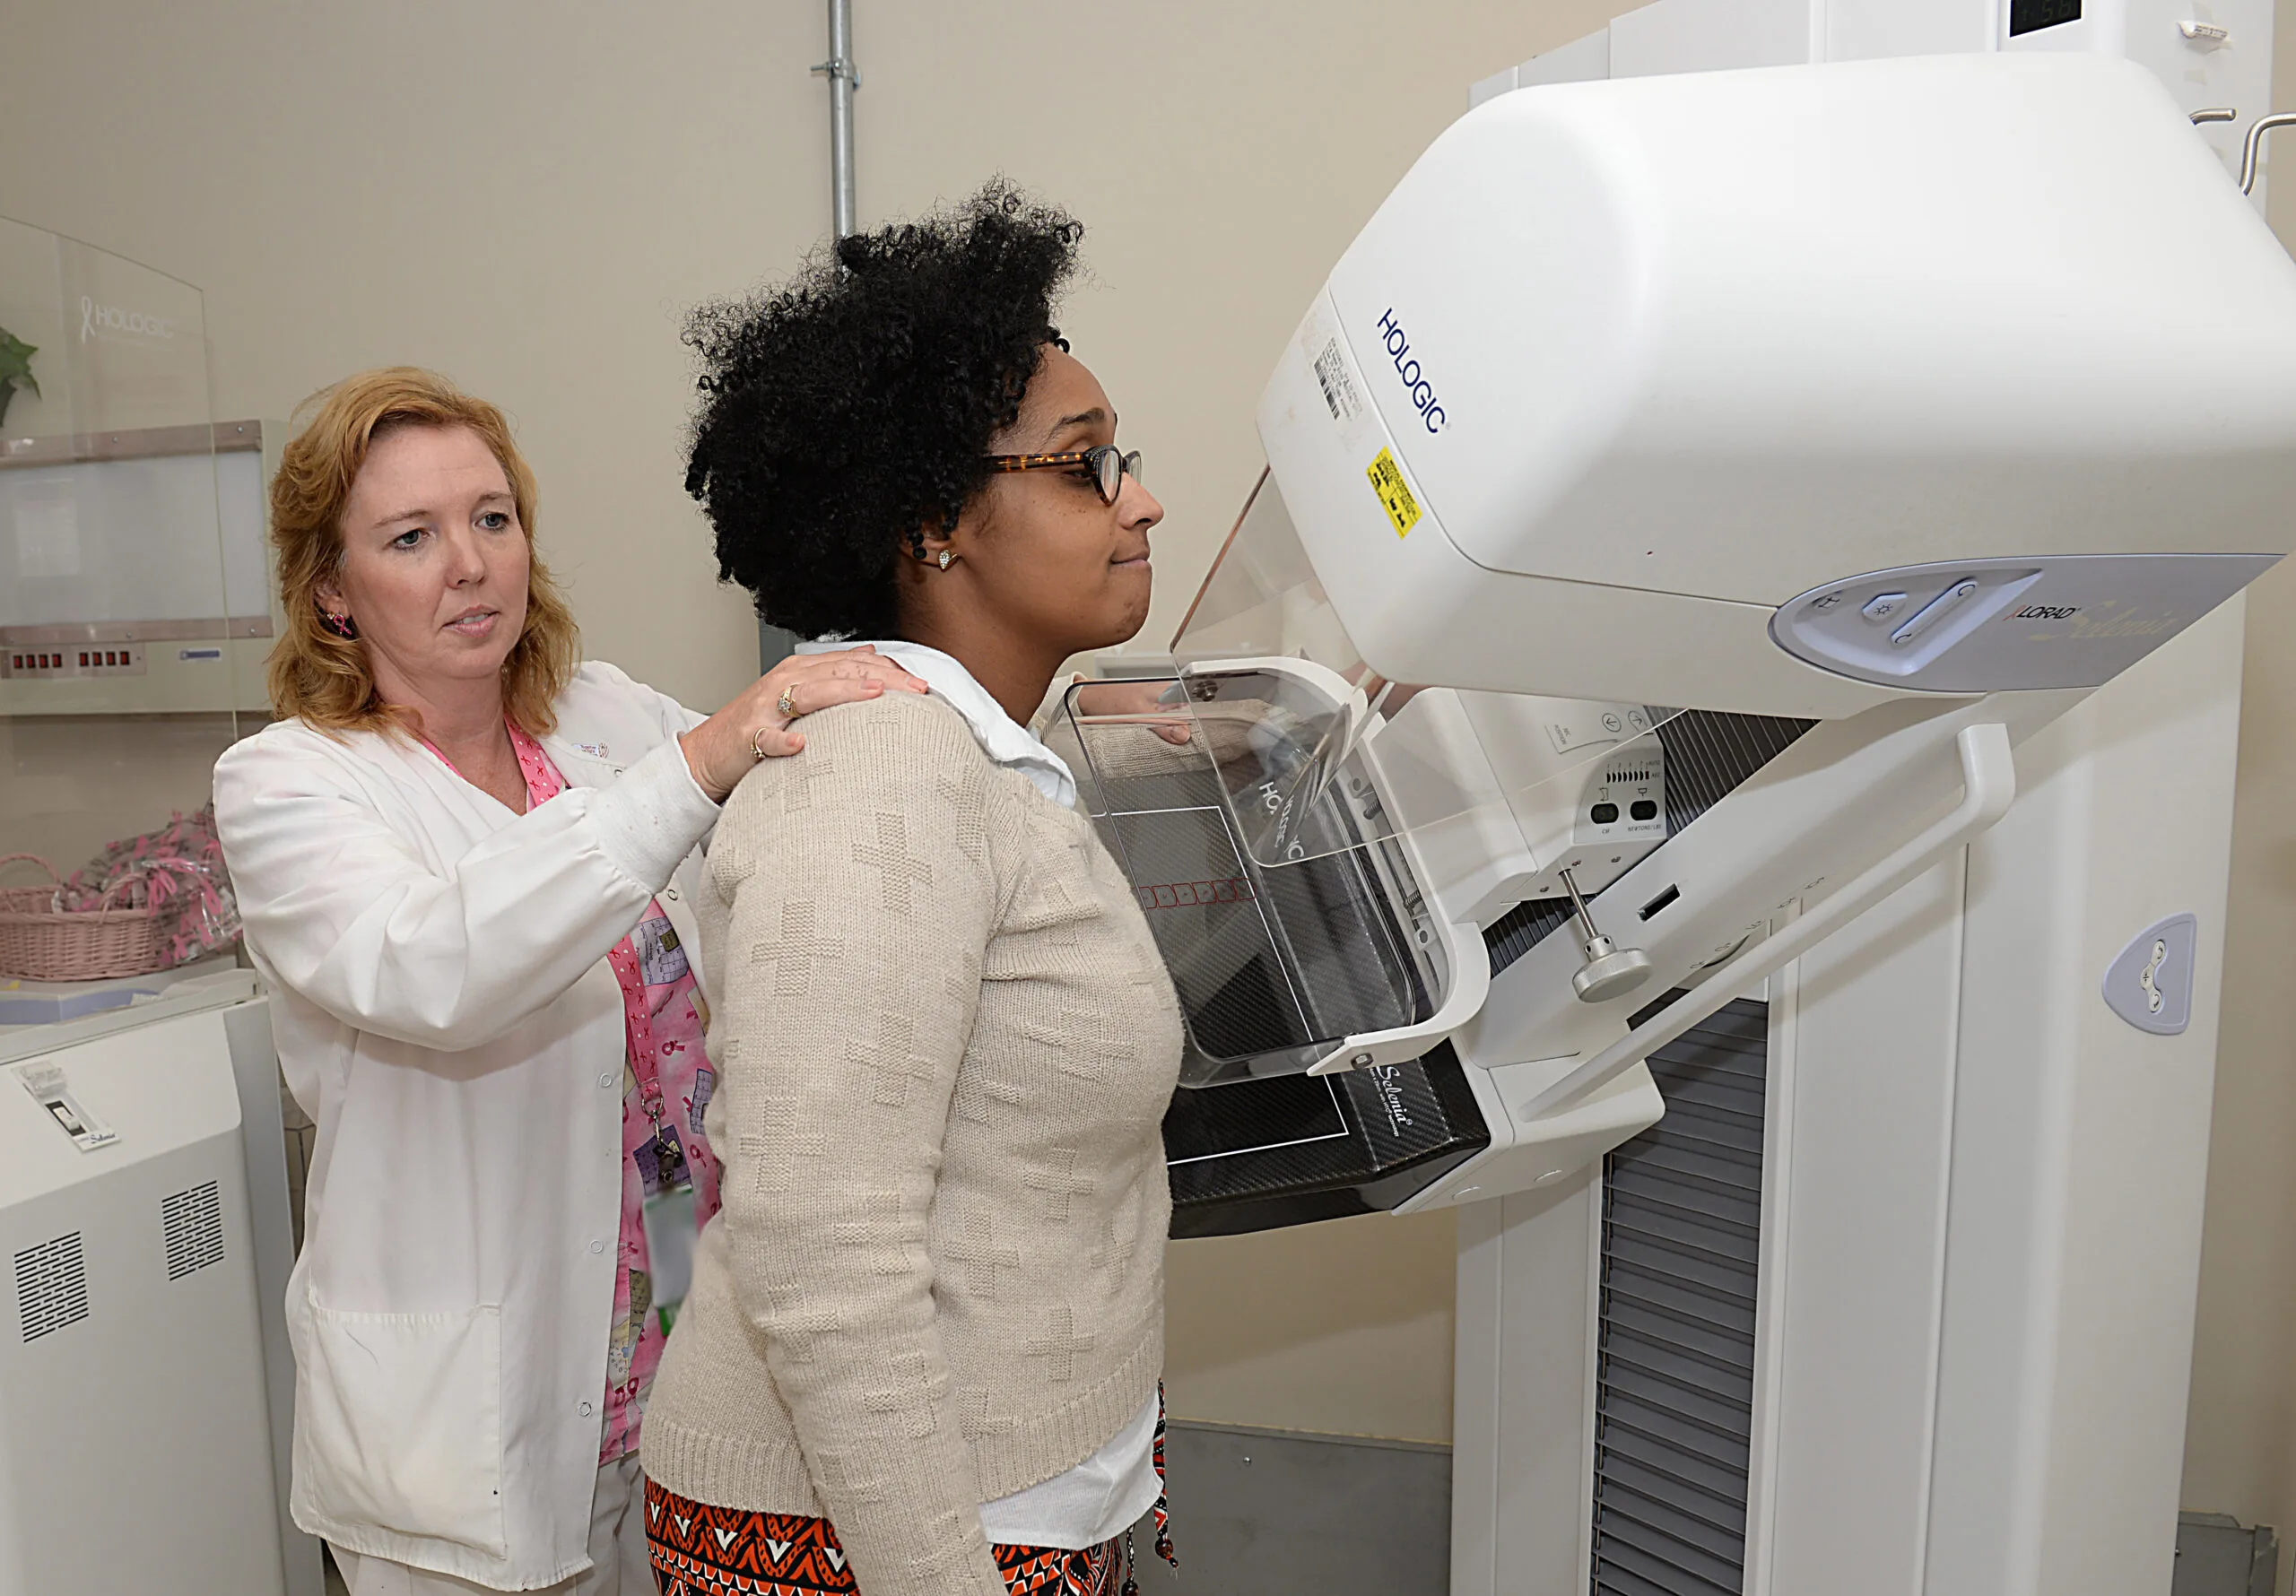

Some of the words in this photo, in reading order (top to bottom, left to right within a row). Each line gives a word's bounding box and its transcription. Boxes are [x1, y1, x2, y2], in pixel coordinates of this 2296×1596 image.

[1377, 308, 1446, 434] HOLOGIC
[2016, 605, 2077, 620] LORAD
[1376, 1066, 1406, 1123] Selenia
[1387, 1114, 1399, 1137] technology
